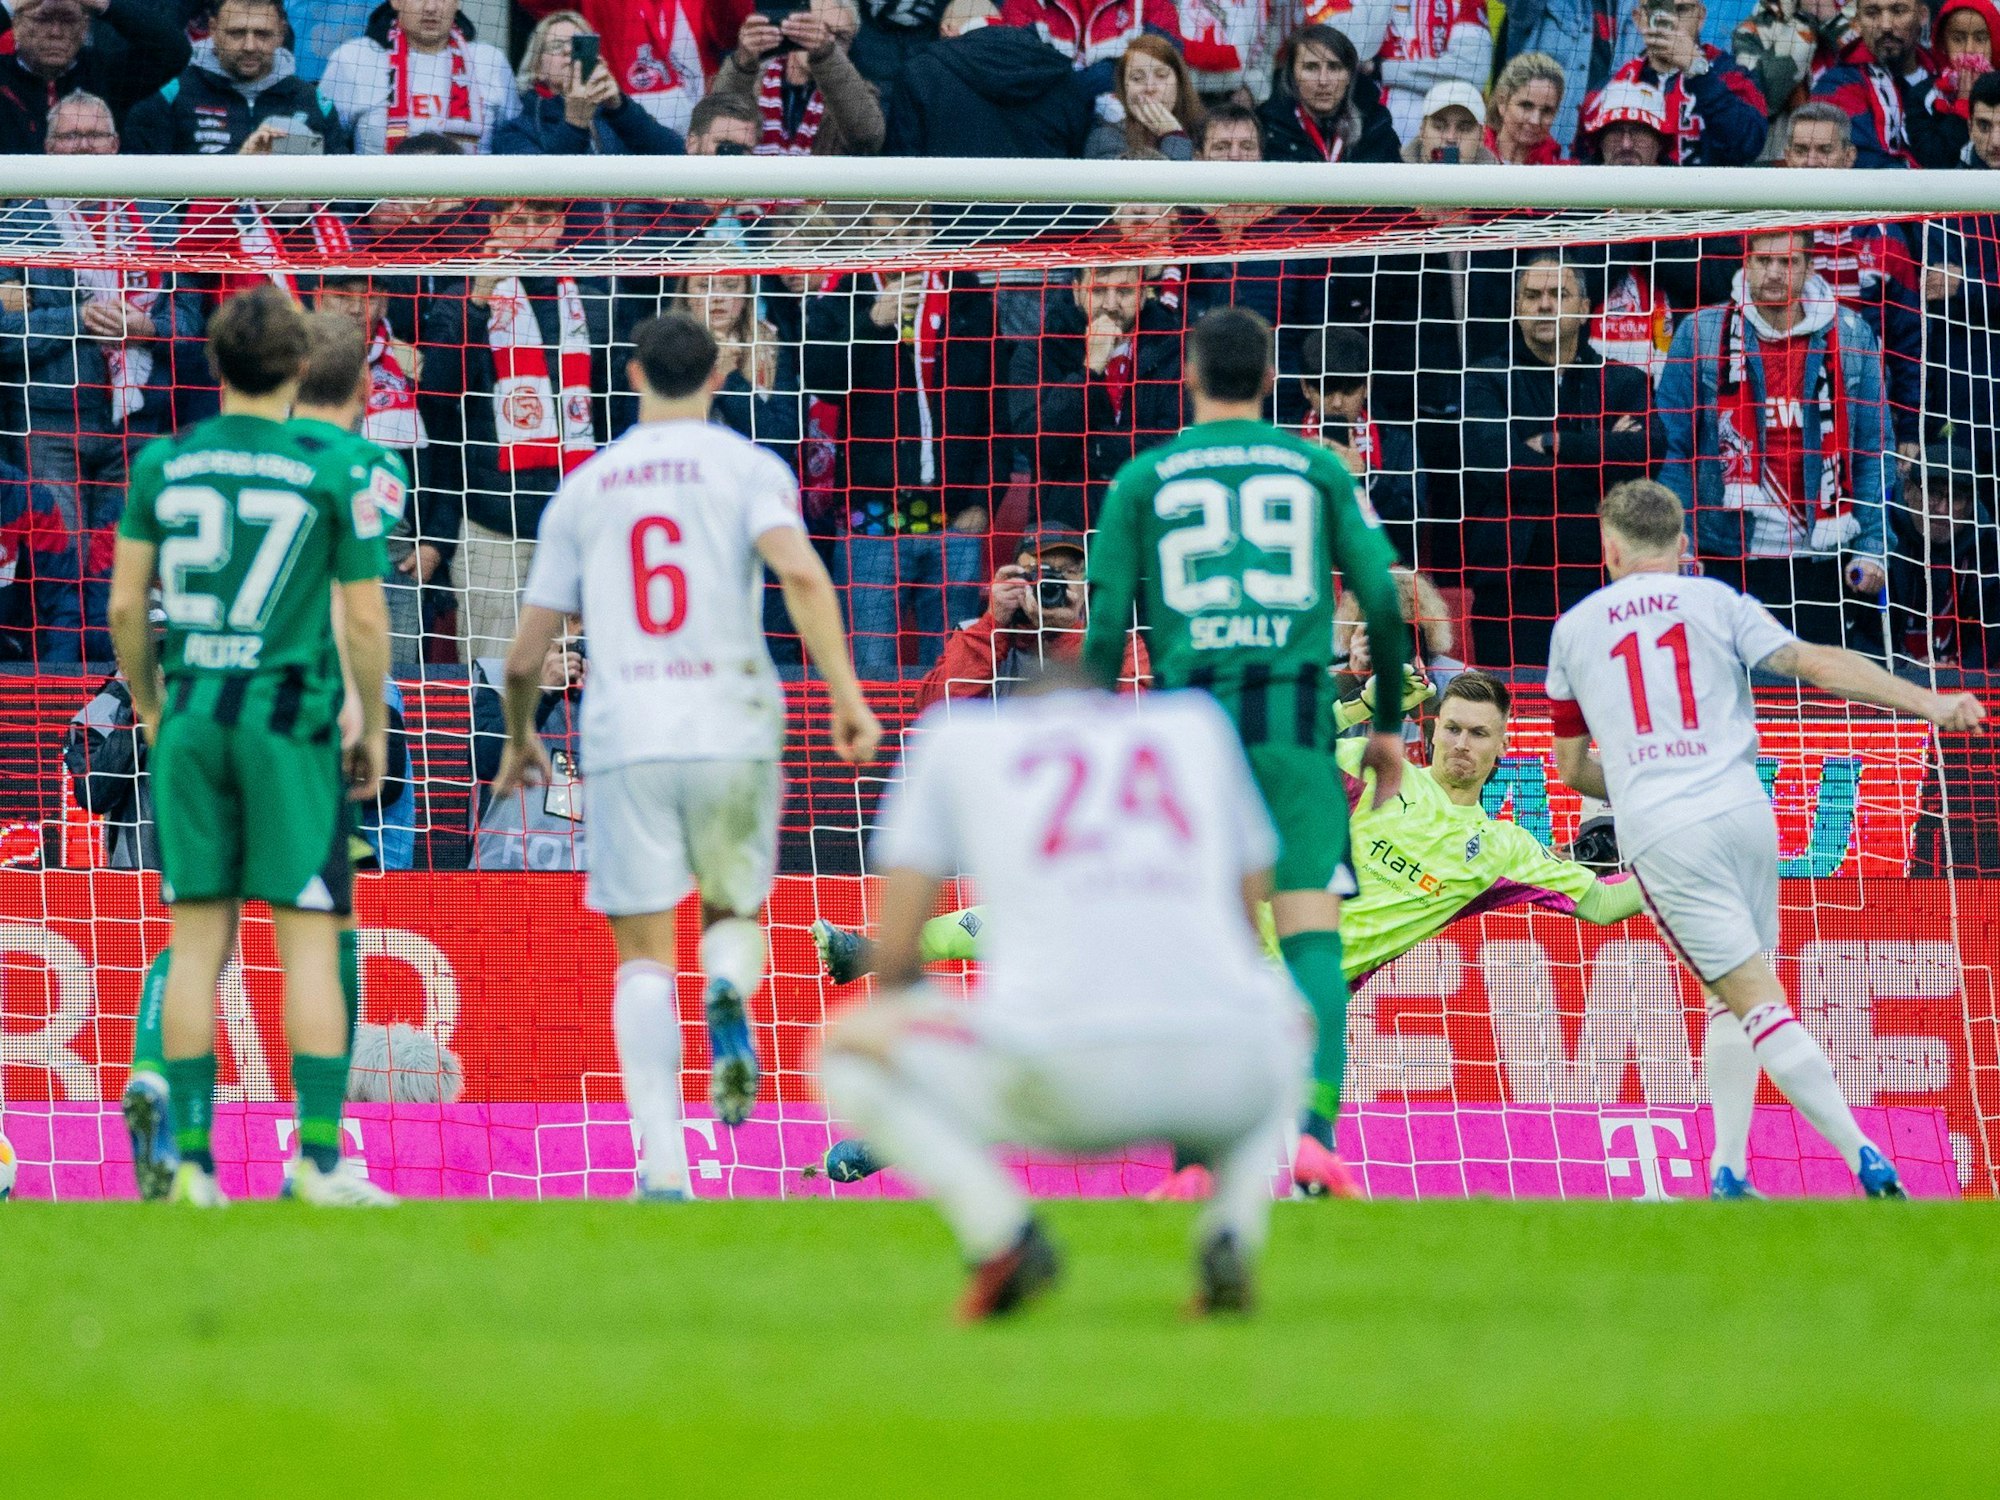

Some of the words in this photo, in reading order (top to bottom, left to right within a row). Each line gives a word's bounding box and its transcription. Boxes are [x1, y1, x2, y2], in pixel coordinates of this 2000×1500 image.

[600, 459, 703, 492] MARTEL
[155, 485, 319, 632] 27
[629, 514, 688, 637] 6
[1154, 474, 1322, 617] 29
[1189, 615, 1292, 650] SCALLY
[1608, 594, 1680, 624] KAINZ
[1610, 622, 1699, 735] 11
[1665, 739, 1708, 758] KÖLN
[1010, 736, 1194, 862] 24
[1600, 1117, 1695, 1199] T
